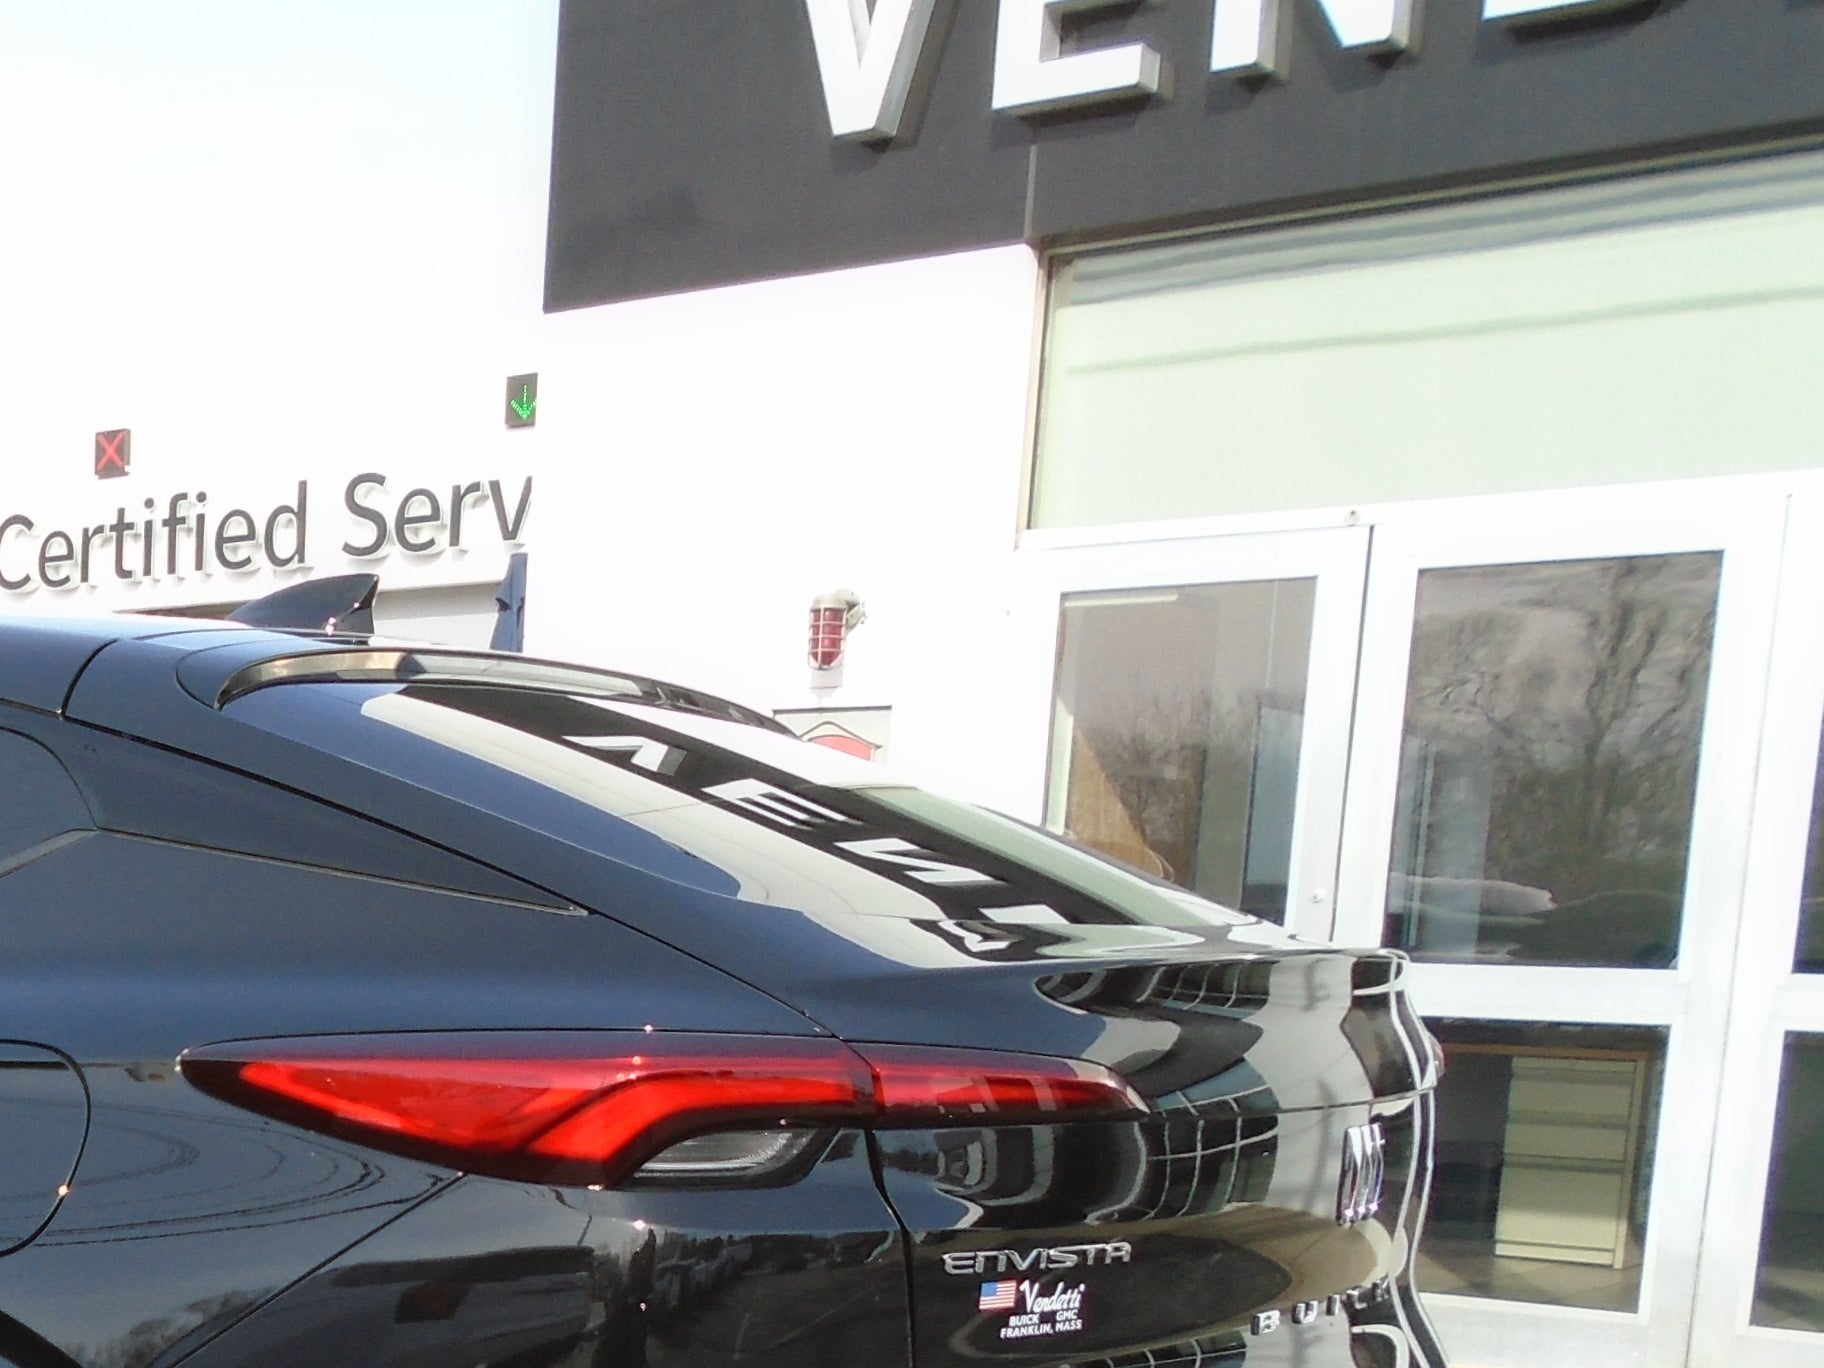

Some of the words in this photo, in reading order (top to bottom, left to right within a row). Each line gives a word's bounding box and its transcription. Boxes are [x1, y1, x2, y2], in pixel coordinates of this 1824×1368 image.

[807, 0, 1646, 138] VE
[341, 472, 532, 557] Serv
[942, 1241, 1132, 1275] ENVISTA
[1019, 1279, 1085, 1313] Vendetti
[1009, 1313, 1040, 1327] BUICK
[1056, 1309, 1078, 1321] GMC
[1055, 1319, 1083, 1332] MASS
